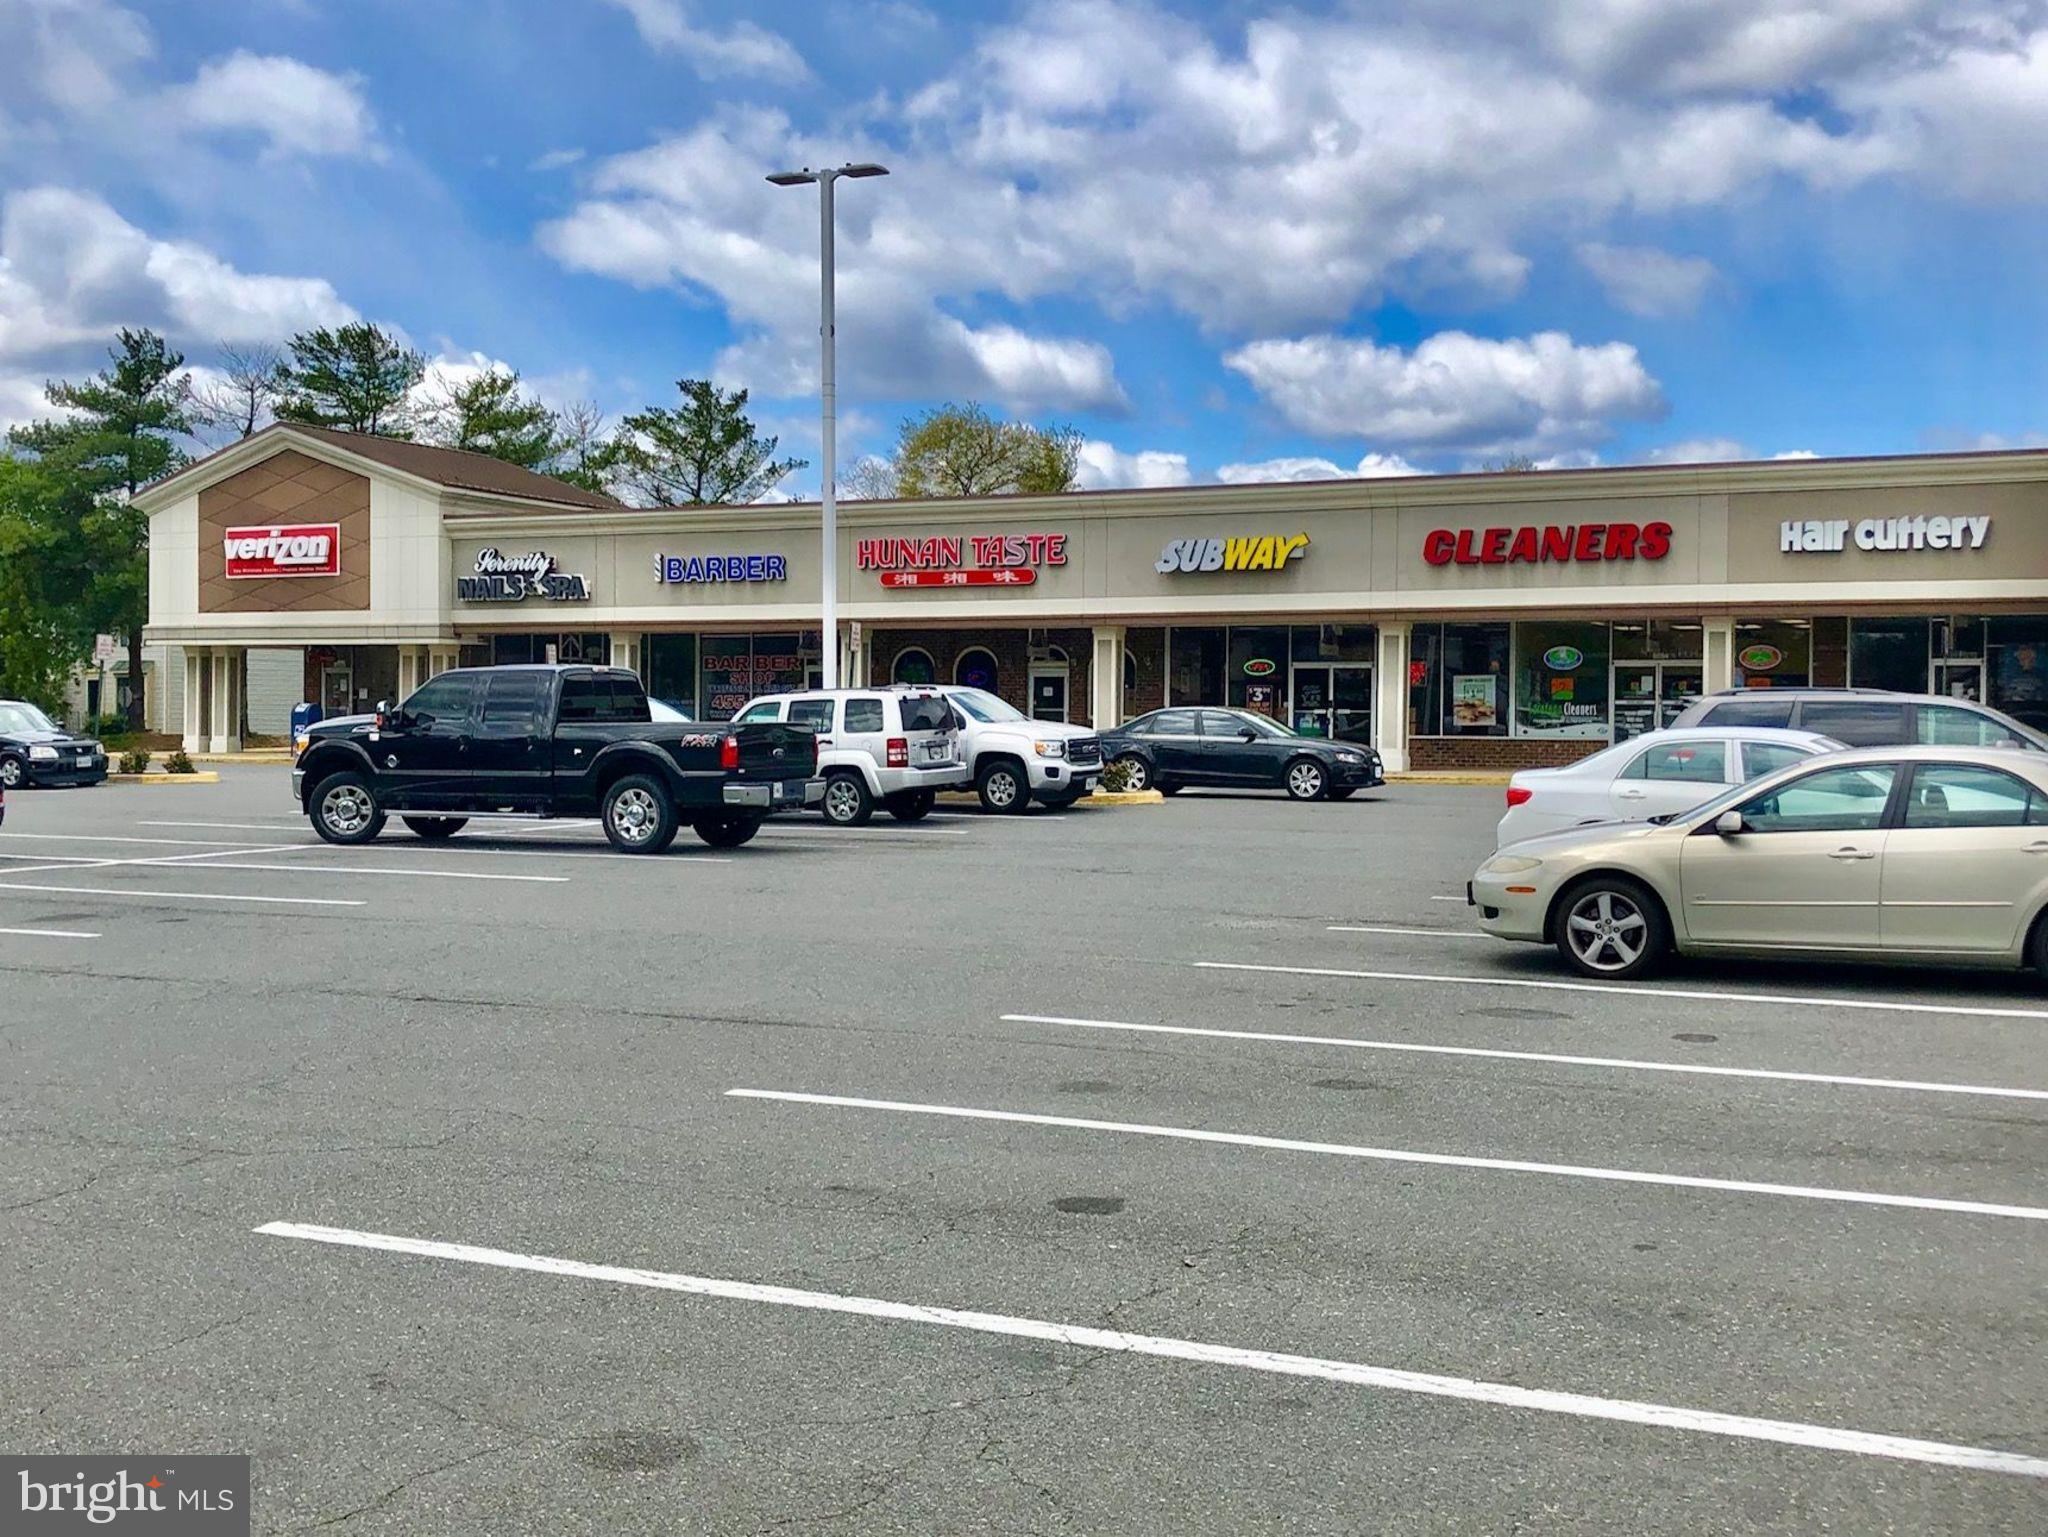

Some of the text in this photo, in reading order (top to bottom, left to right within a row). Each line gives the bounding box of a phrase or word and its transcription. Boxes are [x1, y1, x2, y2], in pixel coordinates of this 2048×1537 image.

[223, 528, 331, 565] verizon
[857, 534, 1068, 568] HUNAN TASTE
[1423, 522, 1672, 565] CLEANERS
[1781, 520, 1849, 551] Hair
[474, 549, 551, 580] Serenity
[1154, 532, 1311, 574] SUBWAY
[665, 555, 786, 583] BARBER
[457, 575, 525, 600] NAILS
[543, 573, 590, 600] SPA
[703, 656, 800, 671] BARBER
[729, 672, 775, 685] SHOP
[1563, 702, 1597, 716] Cleaners
